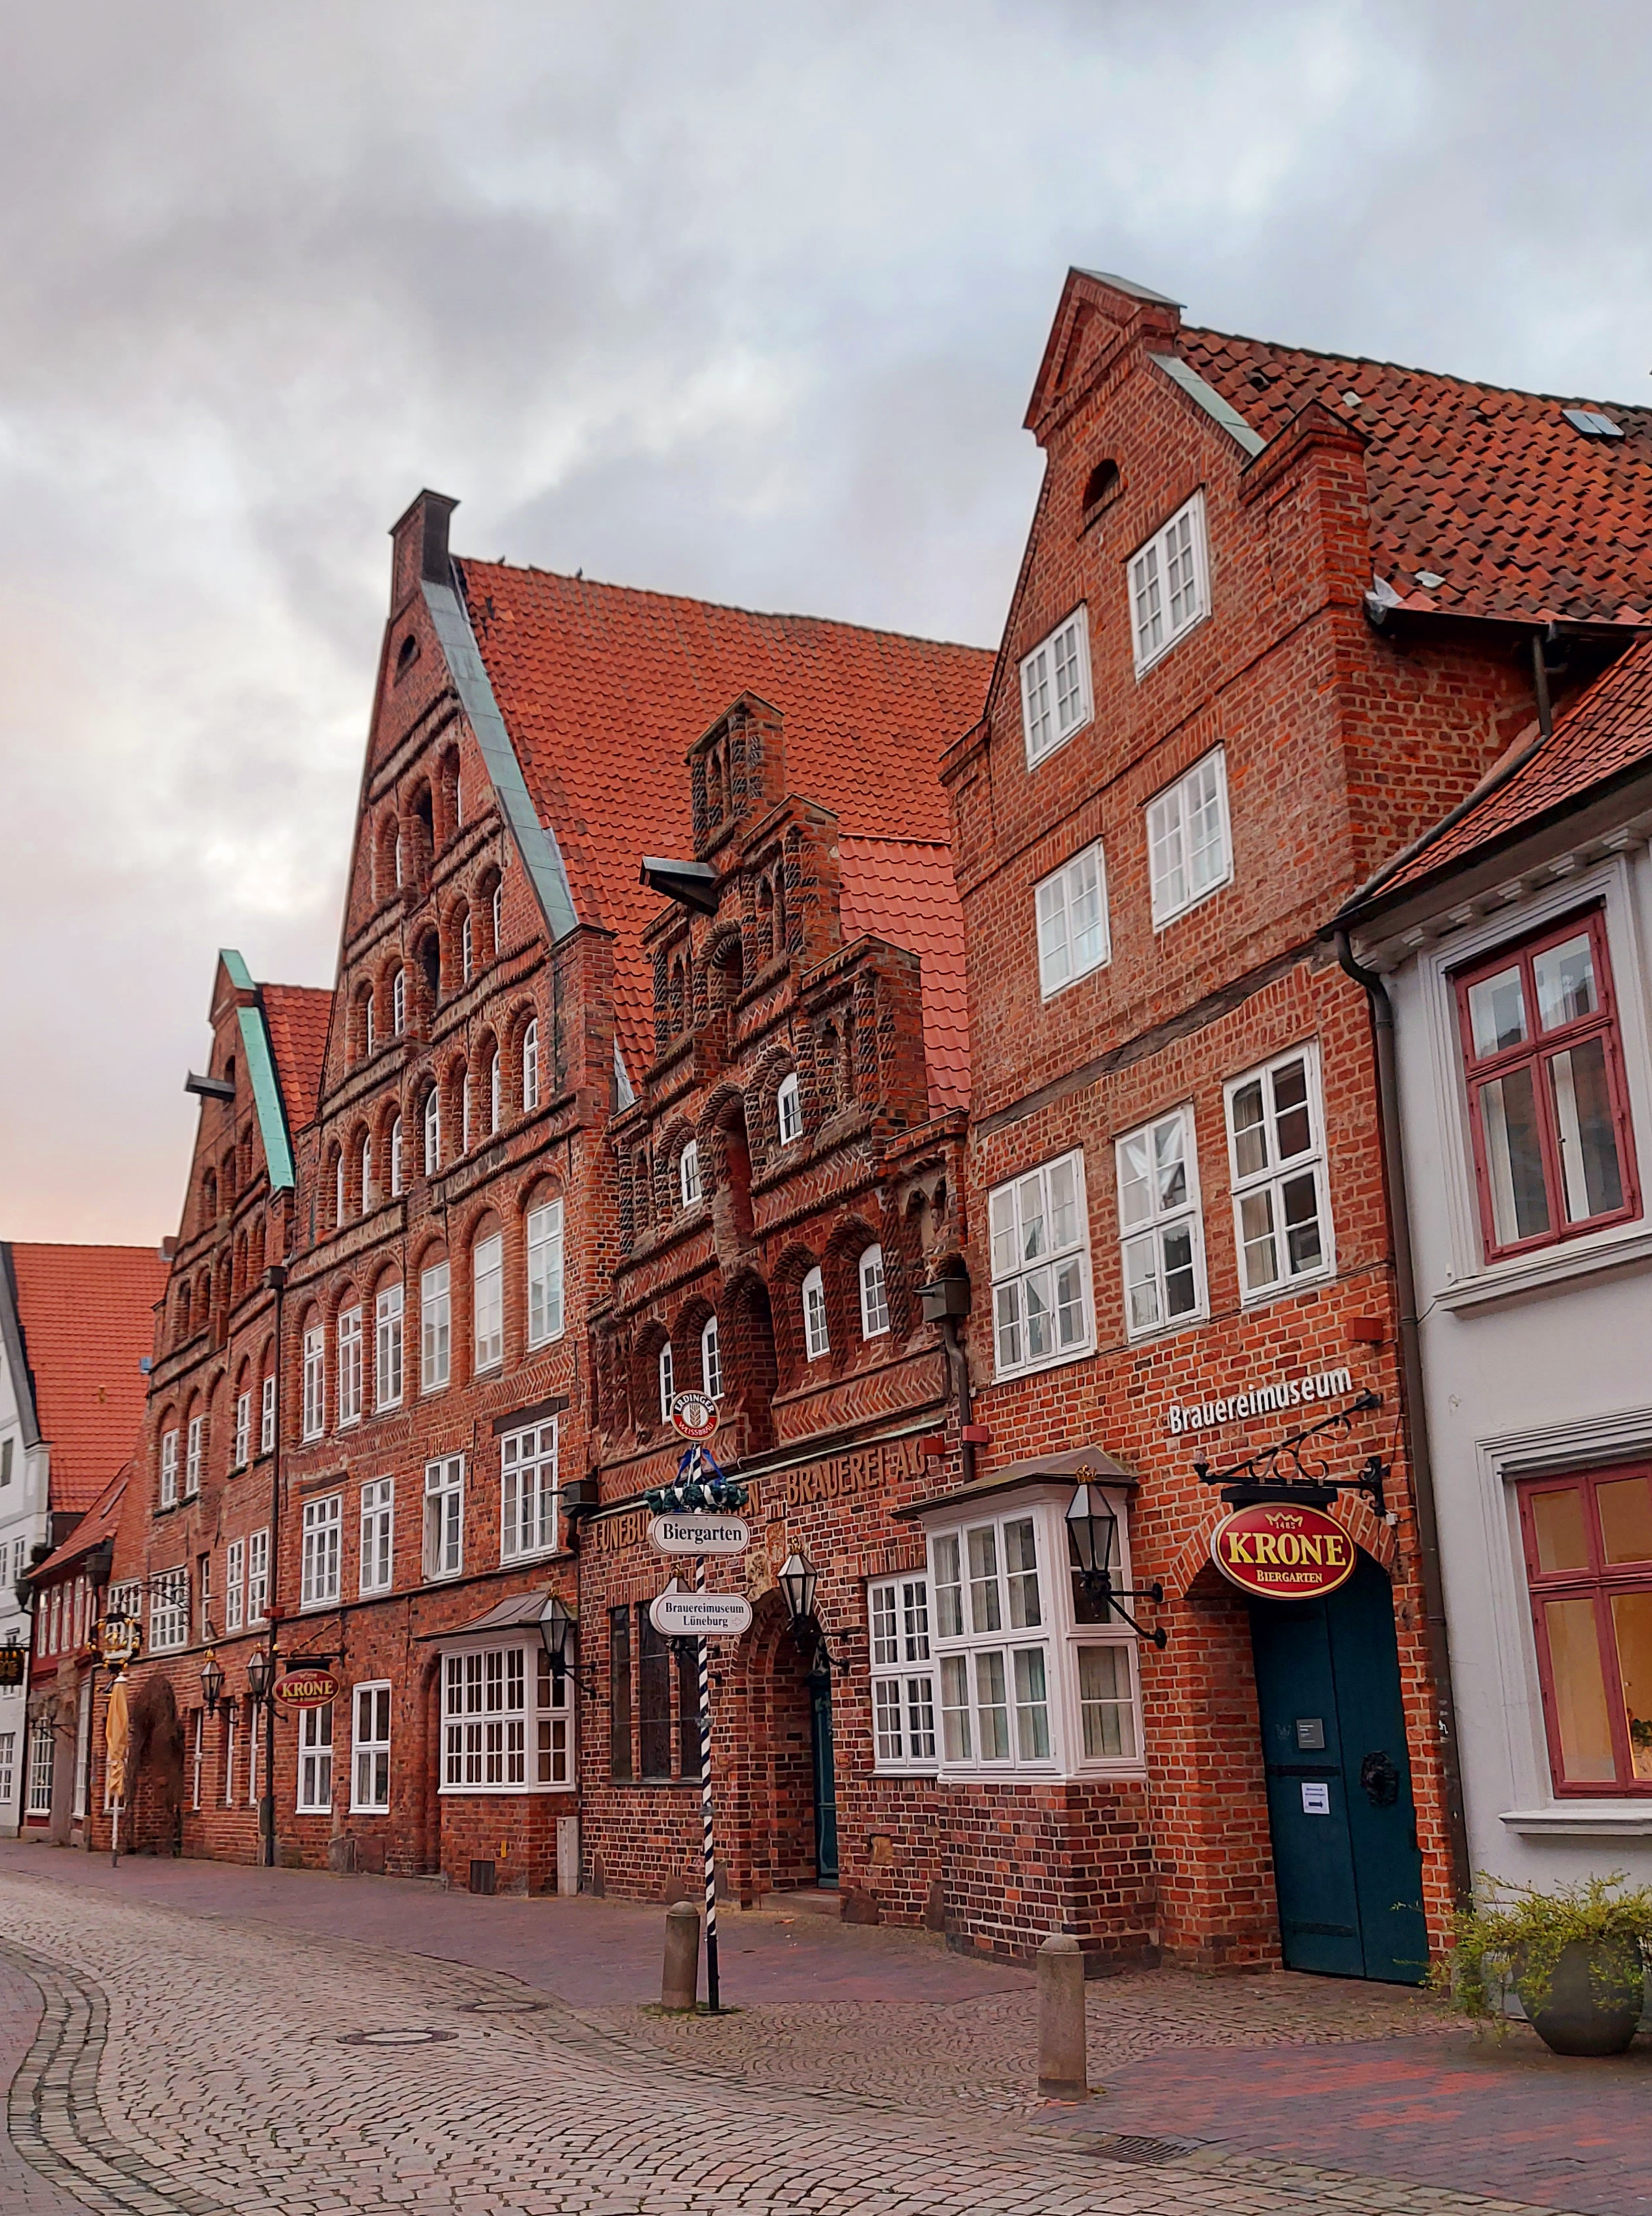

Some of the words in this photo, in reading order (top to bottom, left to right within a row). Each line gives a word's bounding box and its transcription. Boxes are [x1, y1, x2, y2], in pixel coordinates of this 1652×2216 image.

[674, 1394, 715, 1413] ERDINGER
[1169, 1367, 1352, 1434] Brauereimuseum
[662, 1522, 742, 1544] Biergarten
[1226, 1531, 1346, 1566] KRONE
[1256, 1569, 1323, 1583] BIERGARTEN
[665, 1602, 745, 1613] Brauereimuseum
[683, 1615, 728, 1627] Lüneburg
[281, 1680, 334, 1698] KRONE
